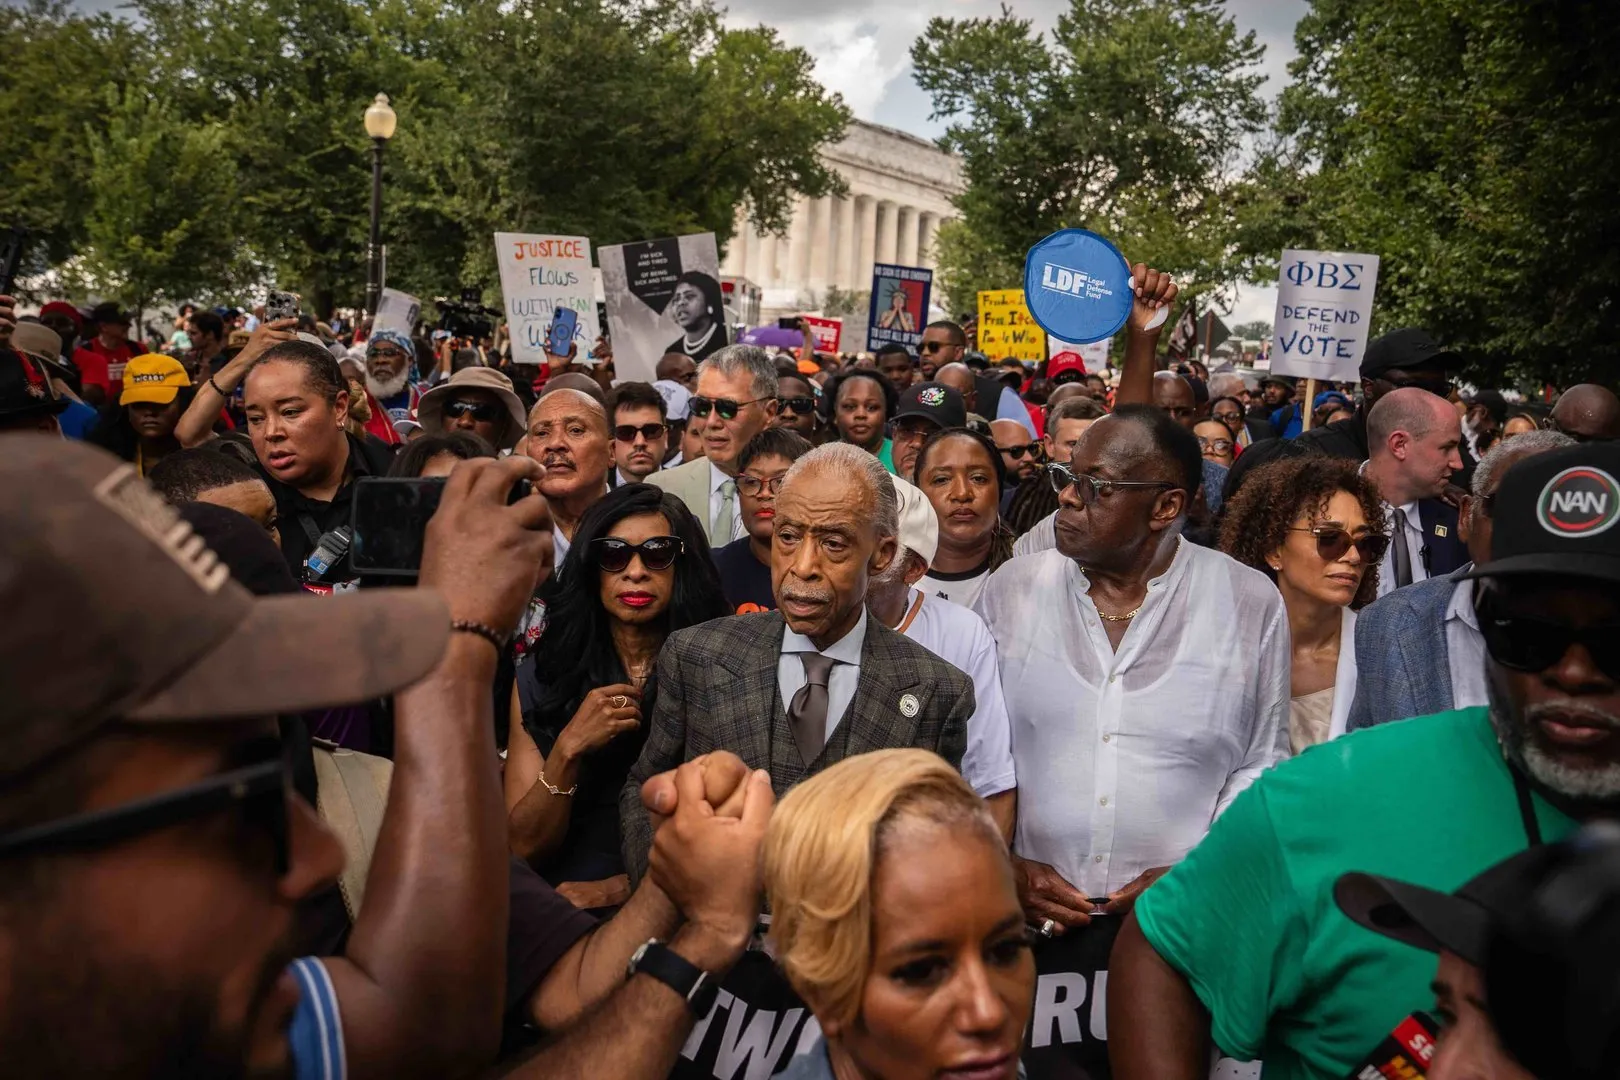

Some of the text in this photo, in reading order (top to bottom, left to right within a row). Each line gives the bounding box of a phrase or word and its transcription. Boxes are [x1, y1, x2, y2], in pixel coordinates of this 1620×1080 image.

[513, 240, 585, 260] JUSTICE
[1042, 264, 1087, 295] LDF
[1086, 283, 1113, 296] Defense
[1087, 276, 1106, 287] Legal
[1085, 290, 1102, 299] Fund
[1282, 305, 1360, 325] DEFEND
[1308, 322, 1329, 334] THE
[1280, 330, 1356, 358] VOTE
[1550, 491, 1608, 514] NAN
